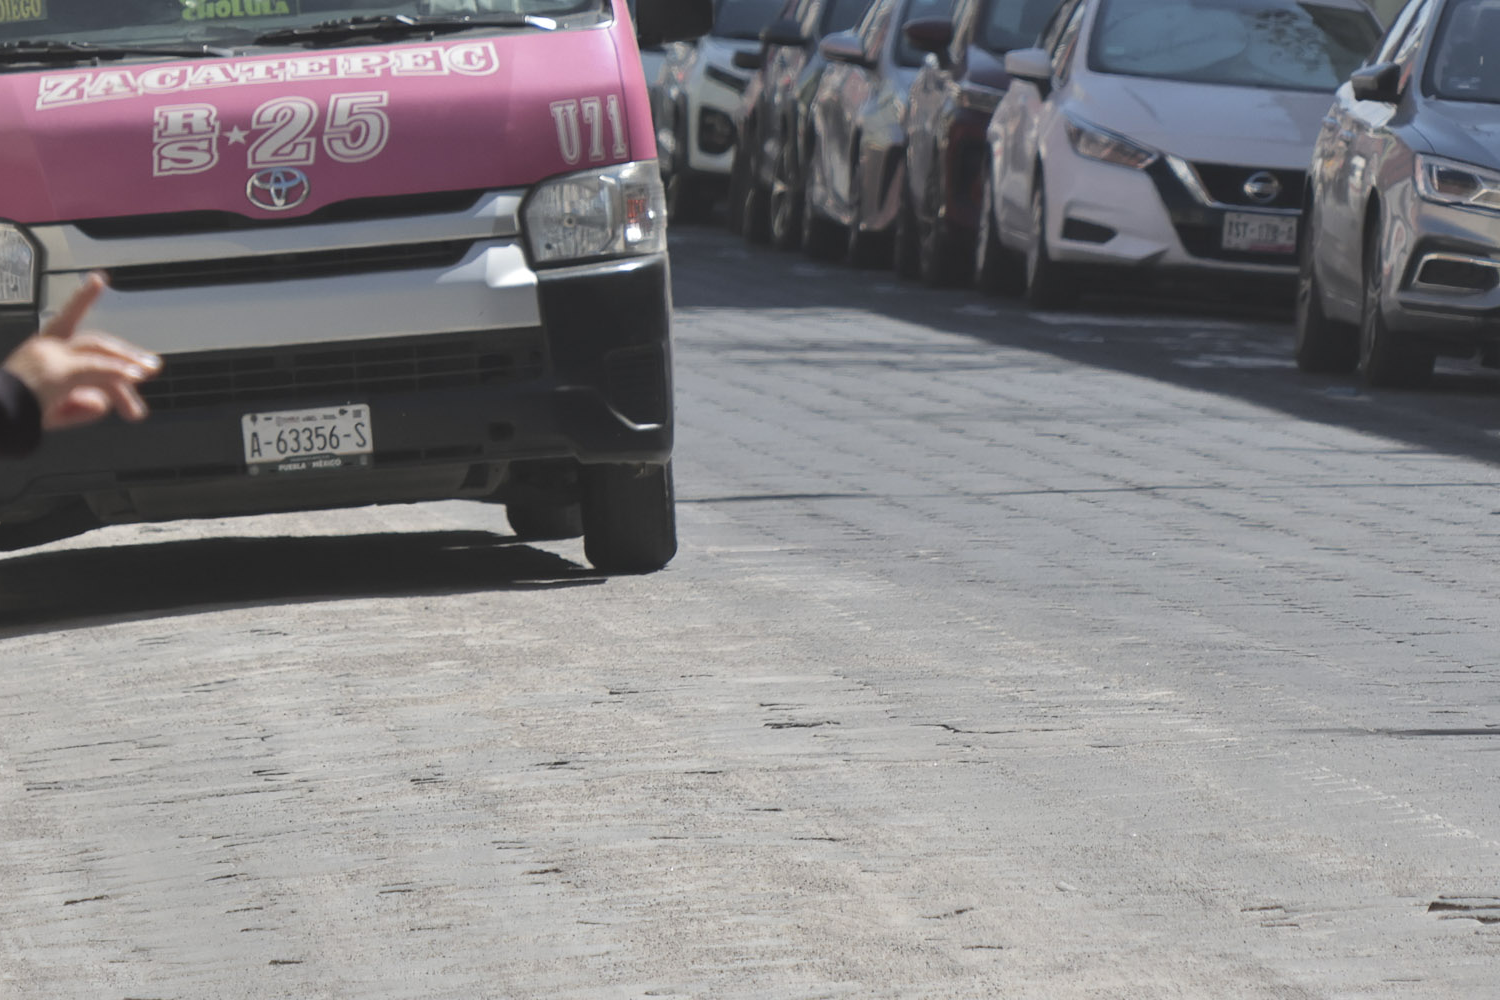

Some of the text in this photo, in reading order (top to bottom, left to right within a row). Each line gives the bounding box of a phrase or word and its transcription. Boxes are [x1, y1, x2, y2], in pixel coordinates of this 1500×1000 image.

[35, 42, 500, 111] ZACATEPEC
[548, 94, 628, 166] U71
[251, 421, 368, 458] A-63356-S
